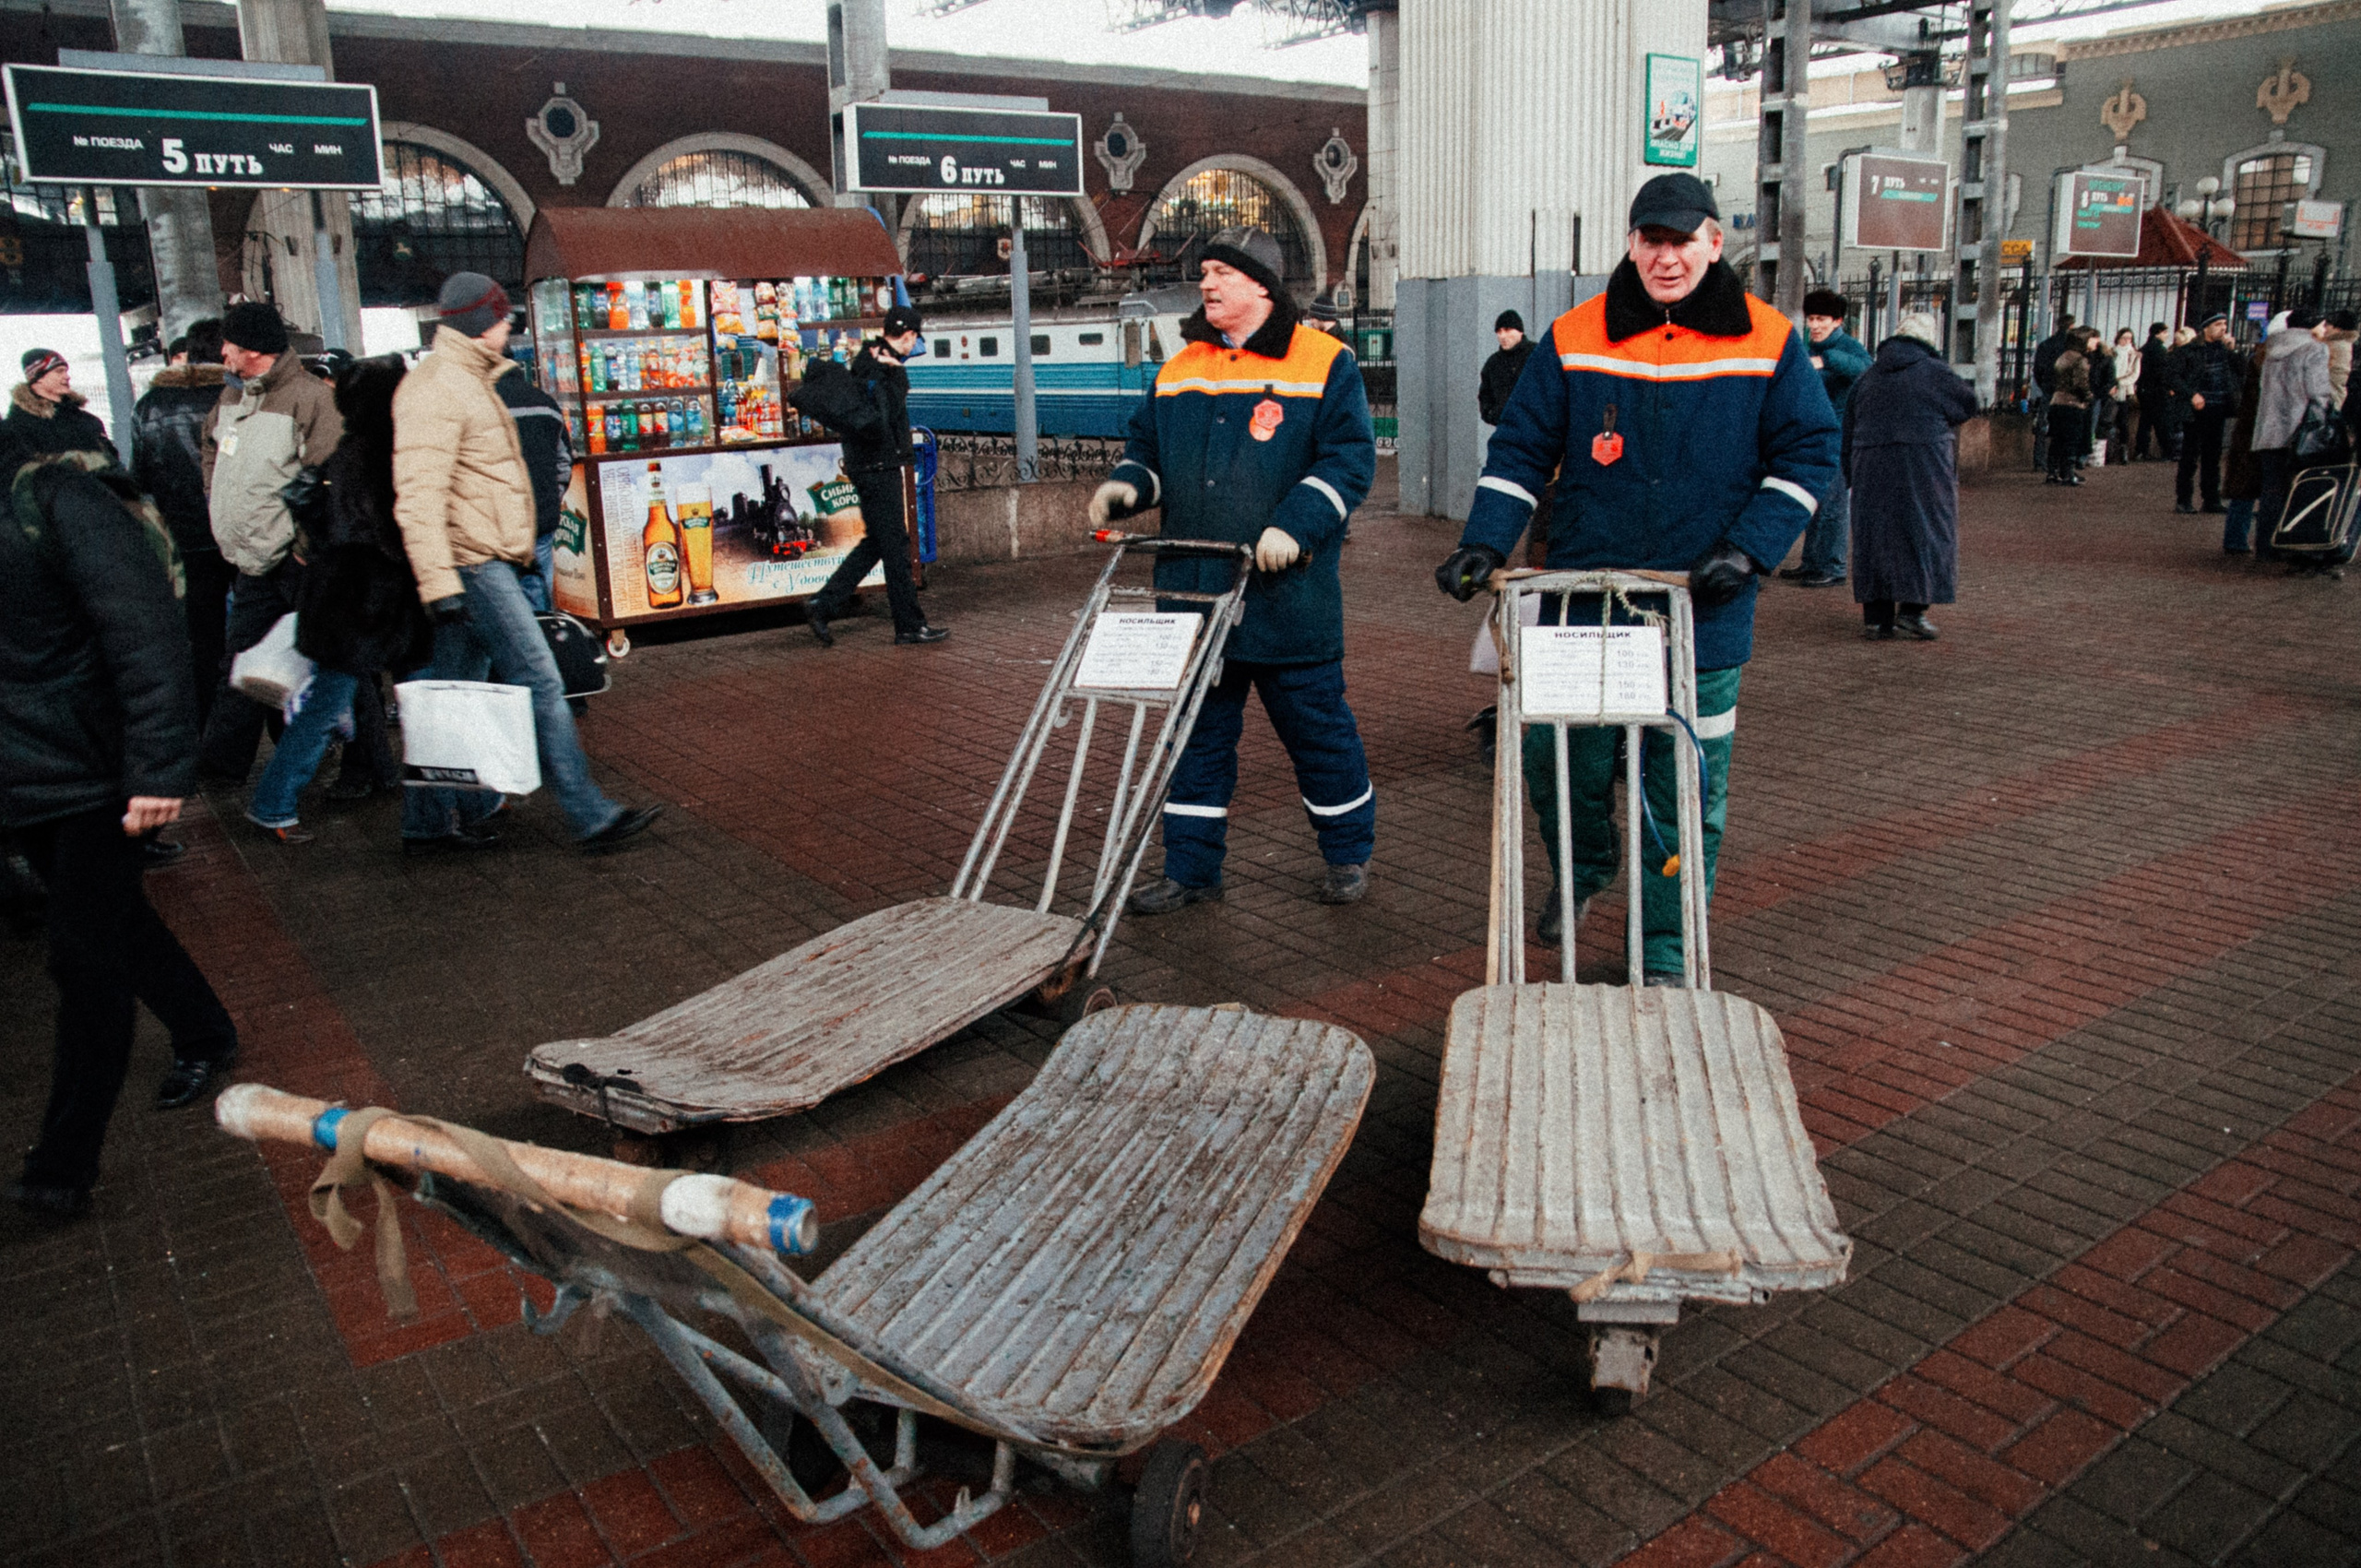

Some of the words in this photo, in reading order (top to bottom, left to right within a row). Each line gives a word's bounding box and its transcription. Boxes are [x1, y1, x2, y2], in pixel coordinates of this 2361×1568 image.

[73, 135, 89, 147] №
[90, 137, 145, 149] ПОЕЗДА
[268, 142, 293, 155] ЧАС
[314, 143, 342, 155] МИН
[161, 137, 189, 174] 5
[194, 152, 265, 175] ПУТЬ
[898, 155, 931, 166] ПОЕЗДА
[940, 155, 958, 184] 6
[961, 166, 1005, 185] ПУТЬ
[1010, 159, 1026, 169] ЧАС
[1038, 160, 1057, 169] МИН
[1870, 174, 1880, 196] 7
[2001, 244, 2029, 255] ССА
[820, 482, 856, 502] СИБИР
[831, 493, 860, 508] КОРО
[1119, 617, 1177, 625] НОСИЛЬЩИК
[1554, 631, 1631, 639] НОСИЛЬЩИК
